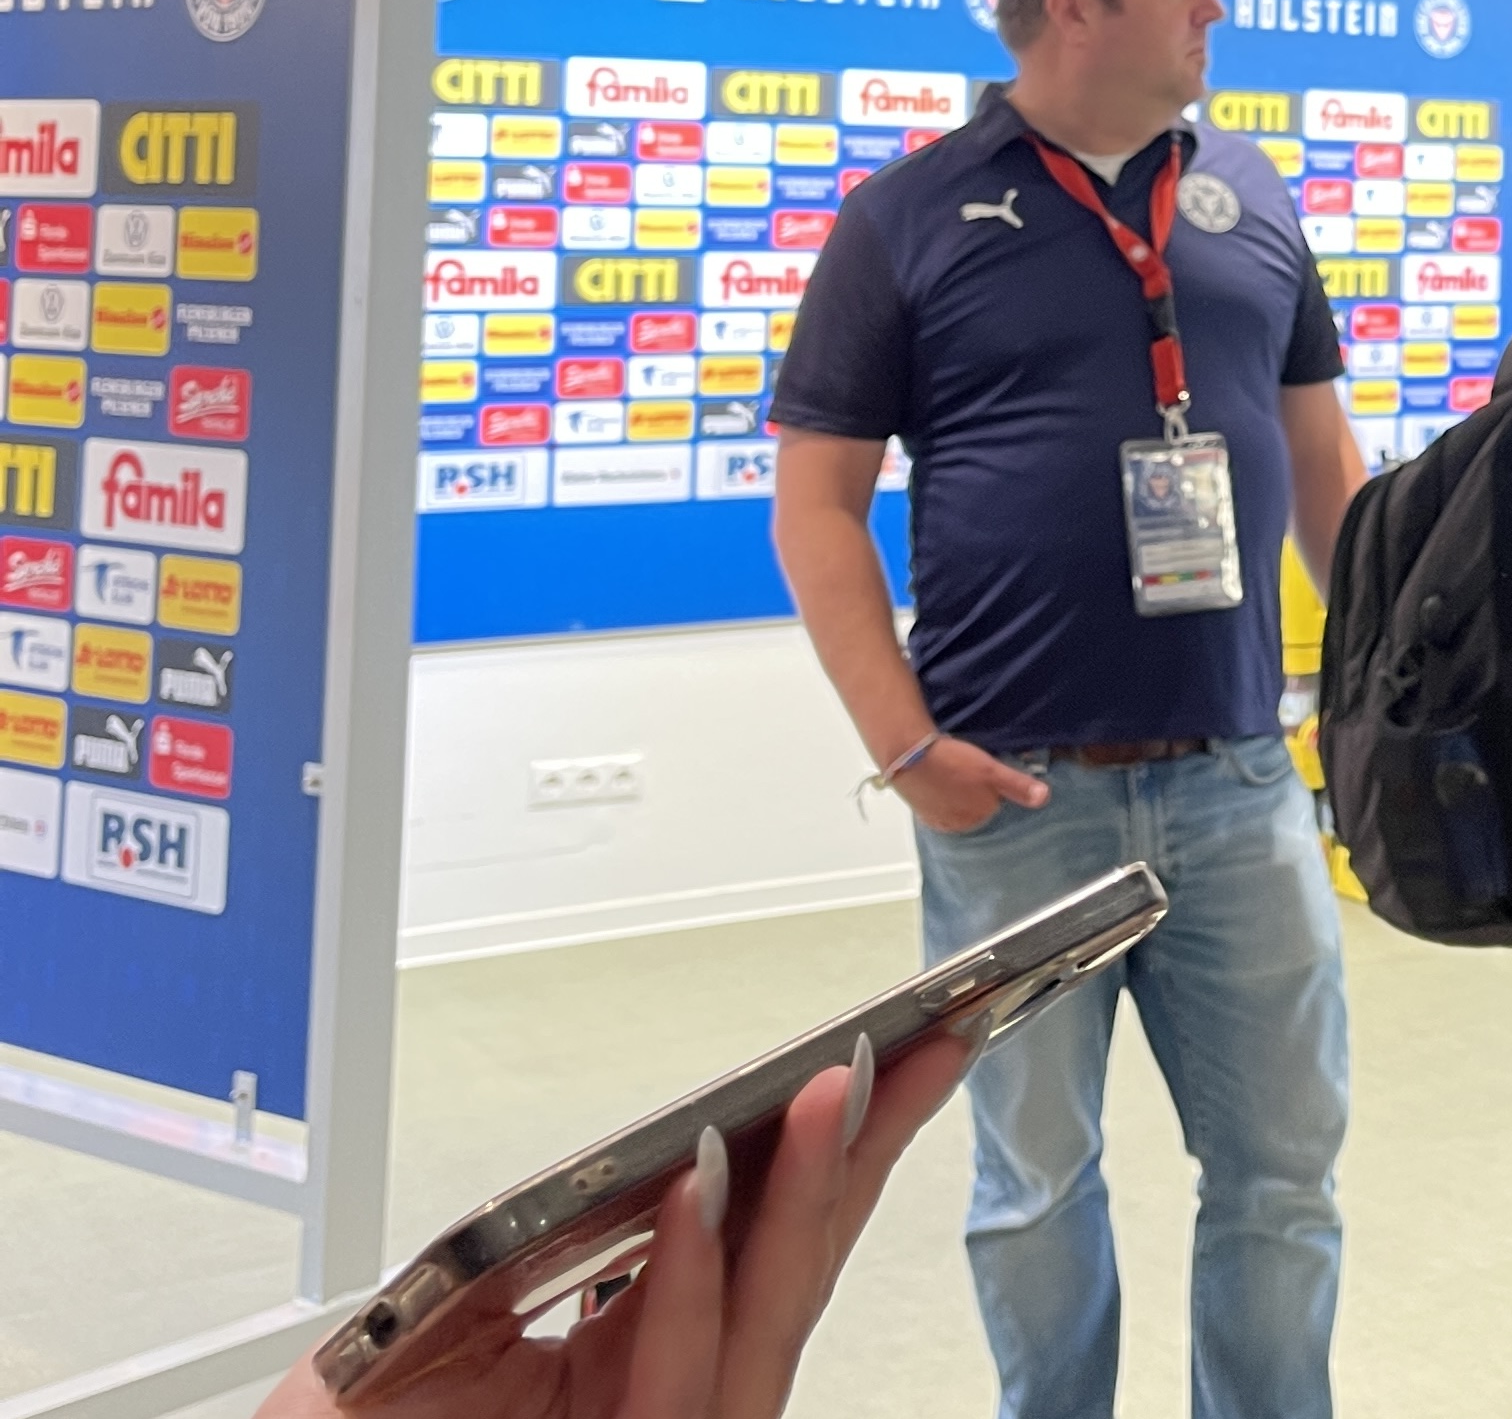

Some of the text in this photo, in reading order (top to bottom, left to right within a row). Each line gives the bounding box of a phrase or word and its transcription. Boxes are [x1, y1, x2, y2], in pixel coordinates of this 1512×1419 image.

[432, 58, 542, 106] CITTI
[586, 67, 688, 107] famila
[722, 70, 821, 116] CITTI
[860, 78, 951, 116] famila
[1210, 92, 1291, 132] CITTI
[1416, 100, 1491, 139] CITTI
[119, 110, 237, 185] CITTI
[422, 259, 539, 302] famila
[574, 258, 679, 303] CITTI
[102, 449, 225, 529] famila
[435, 461, 517, 490] RSH
[101, 812, 187, 869] RSH
